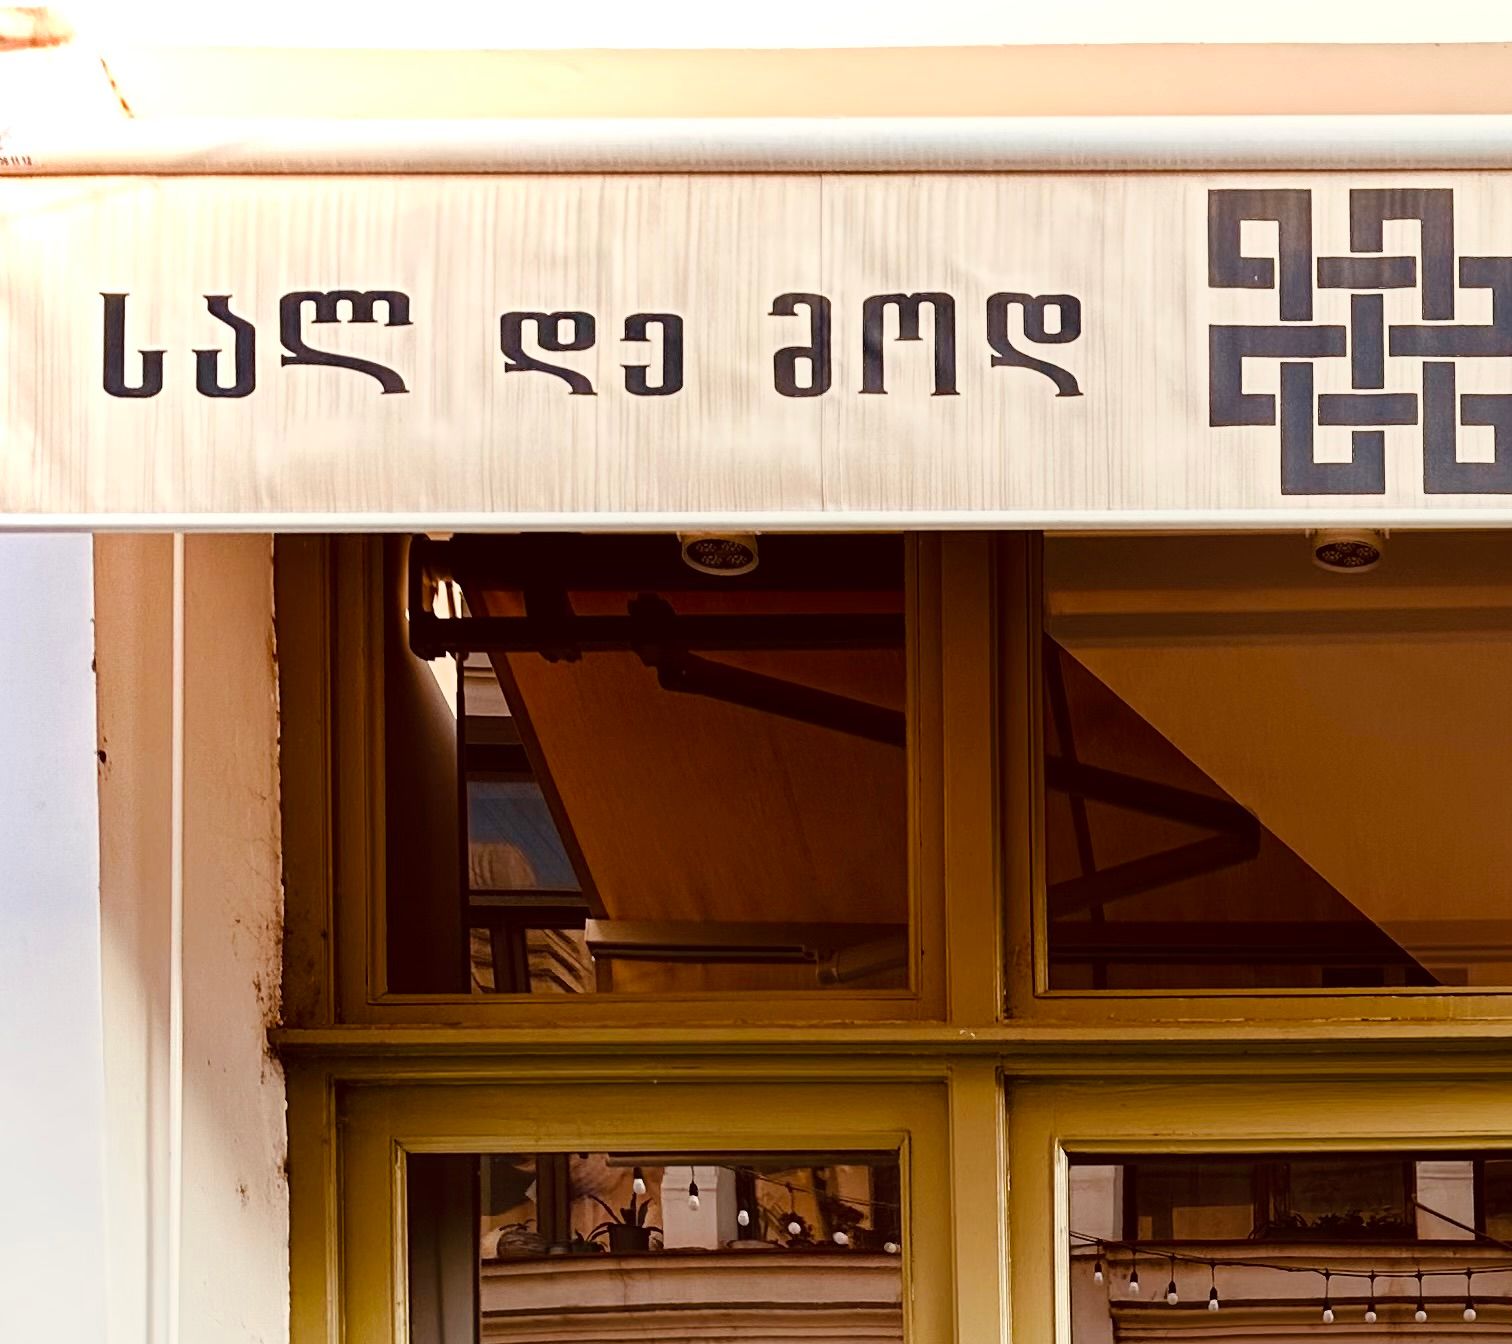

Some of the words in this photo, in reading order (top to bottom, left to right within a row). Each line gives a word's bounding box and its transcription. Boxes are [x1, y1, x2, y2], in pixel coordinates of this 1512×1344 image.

[101, 289, 414, 399] სალ
[499, 310, 684, 397] დე
[767, 291, 1085, 399] მოდ
